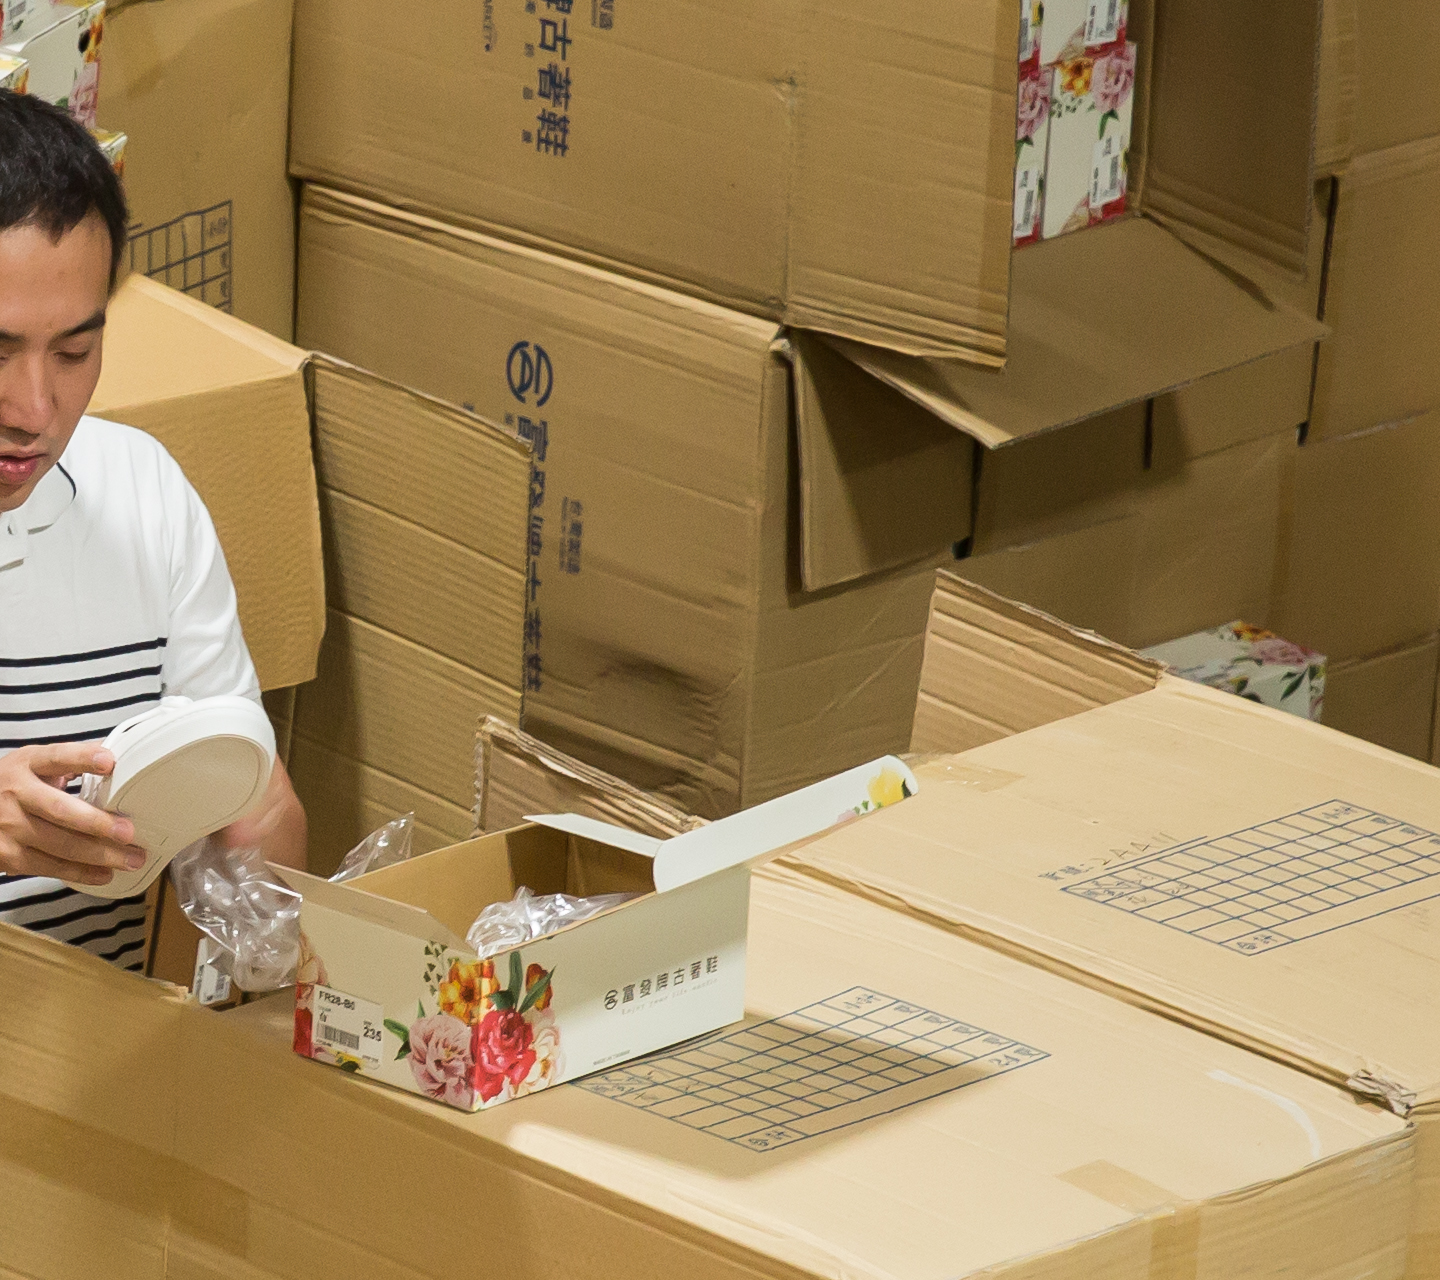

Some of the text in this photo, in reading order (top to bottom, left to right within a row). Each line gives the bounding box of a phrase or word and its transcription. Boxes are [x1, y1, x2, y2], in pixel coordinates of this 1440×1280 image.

[622, 956, 719, 1005] 富發牌古著鞋
[363, 1023, 382, 1042] 235
